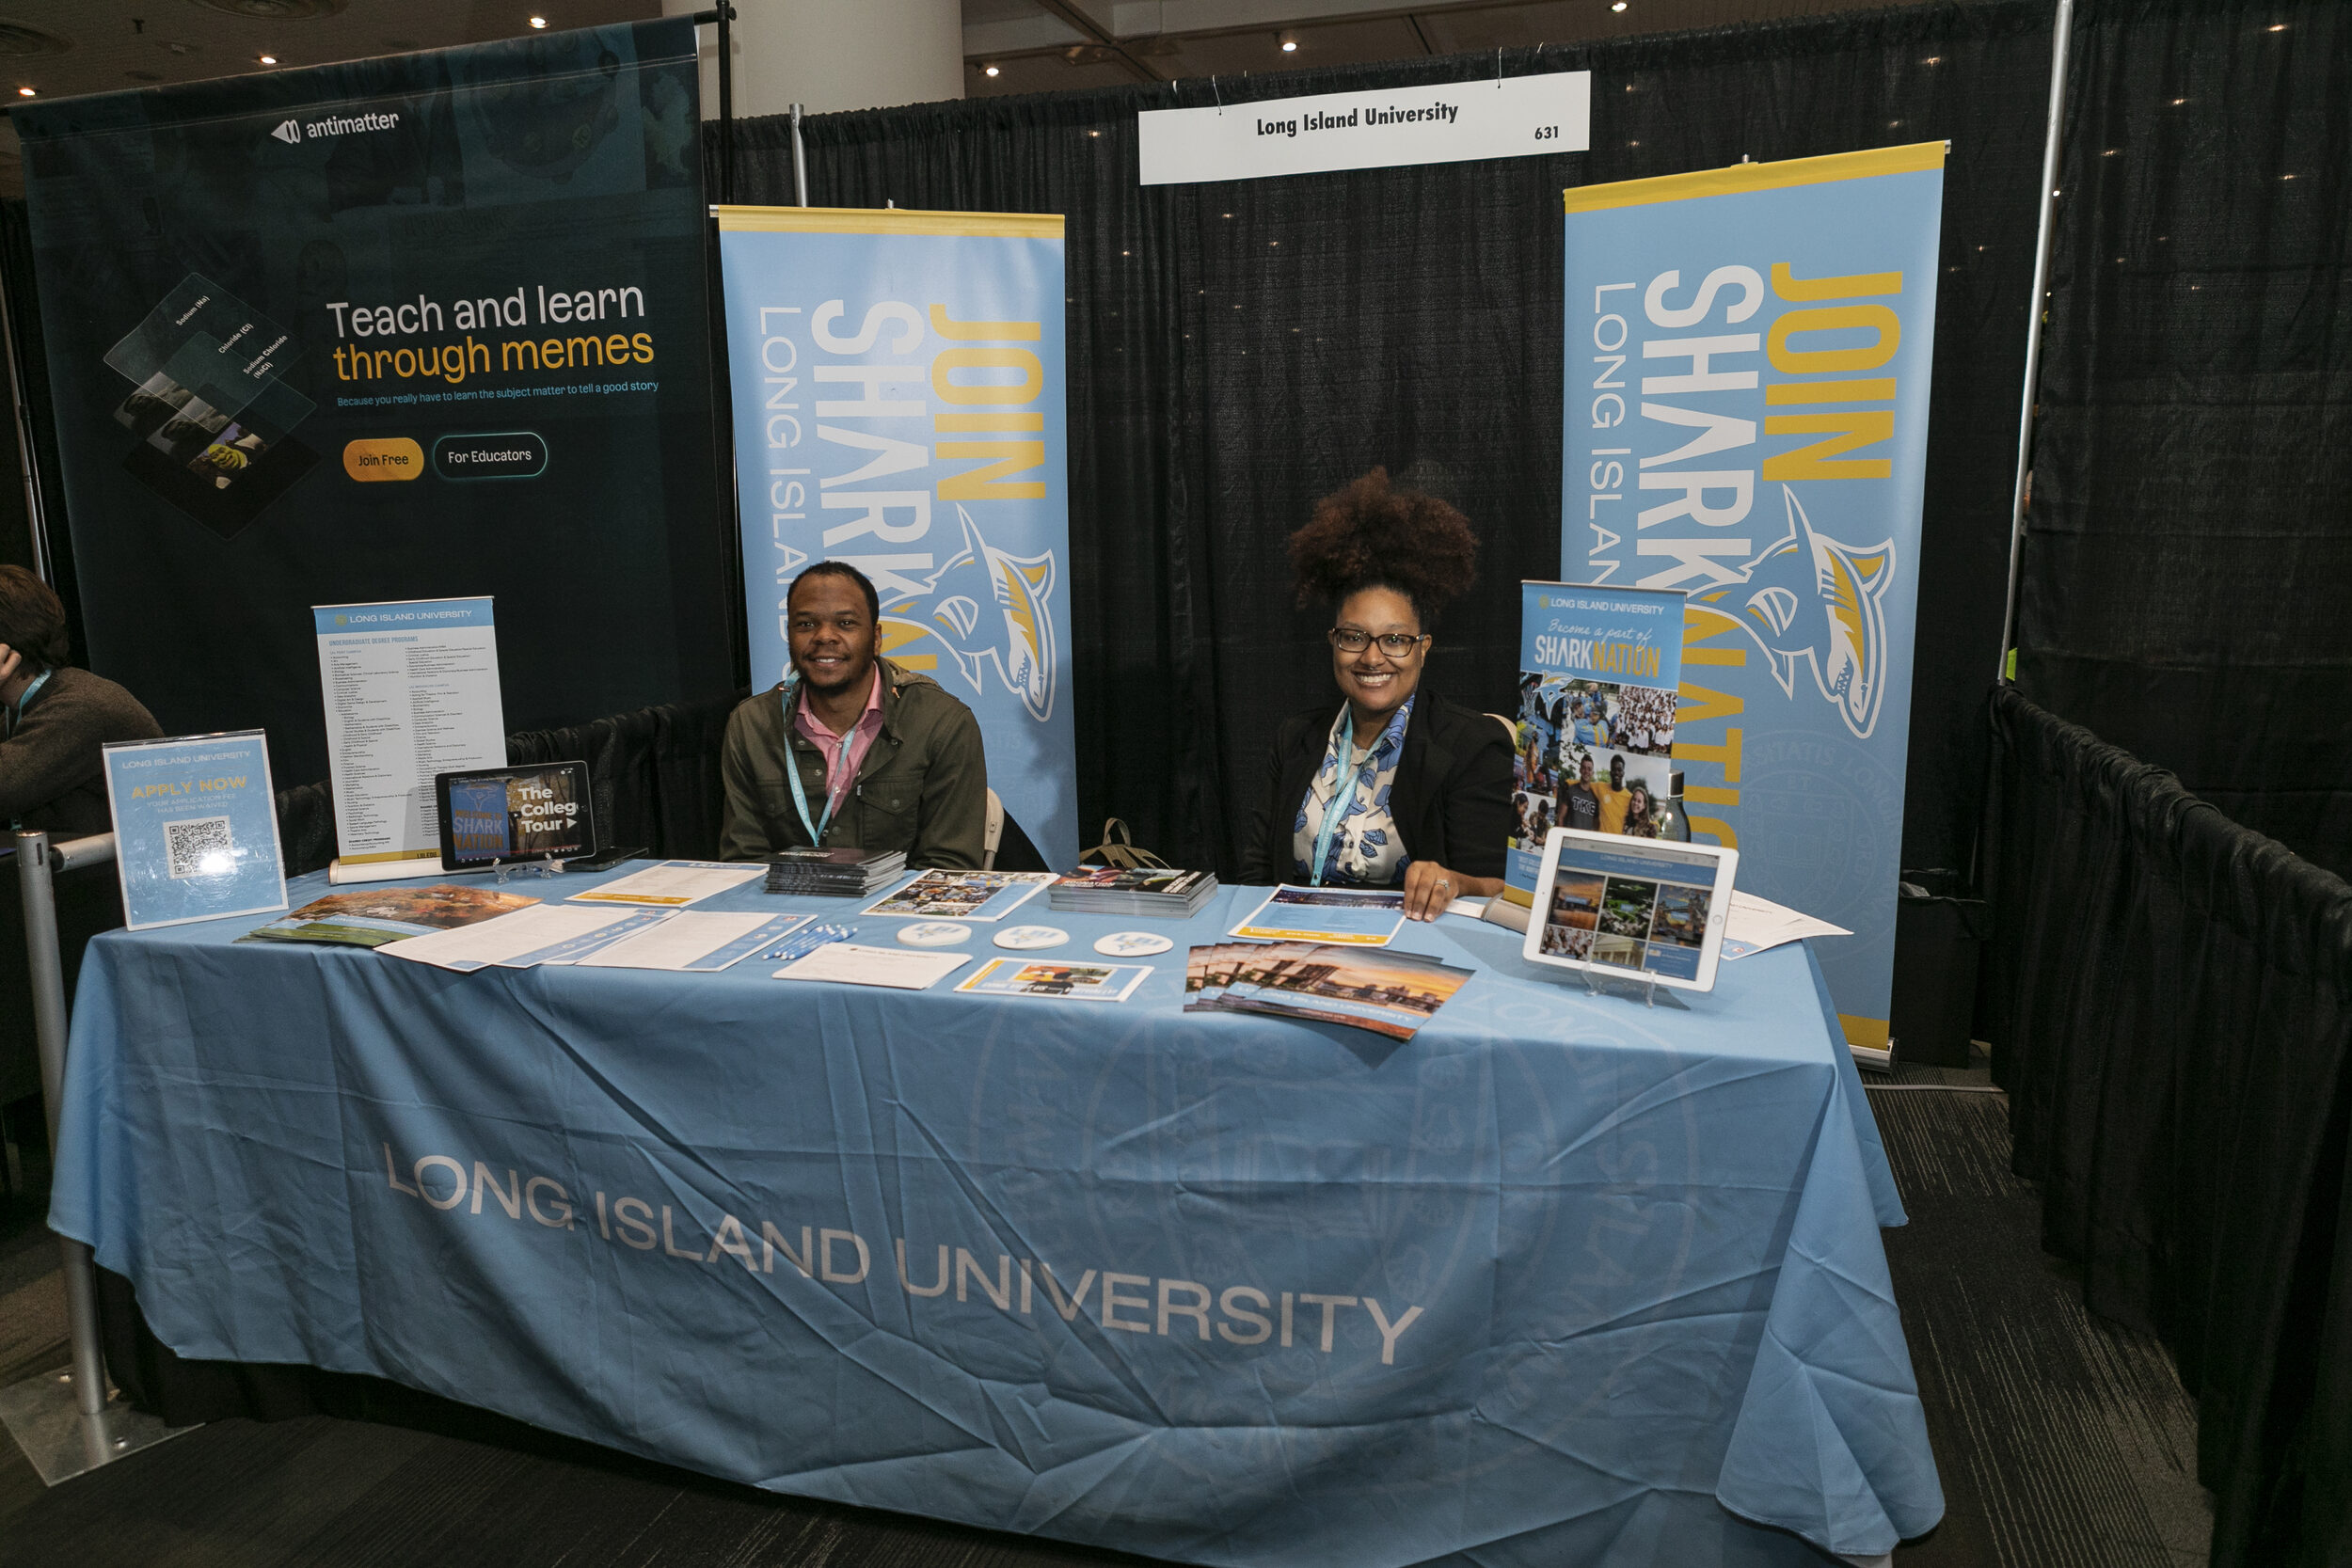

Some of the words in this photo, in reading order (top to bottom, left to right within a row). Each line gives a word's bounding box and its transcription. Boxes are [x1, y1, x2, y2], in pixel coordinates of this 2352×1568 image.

[306, 113, 400, 138] antimatter
[1257, 119, 1297, 138] Long
[1303, 107, 1358, 131] Island
[1365, 102, 1459, 126] University
[1534, 126, 1559, 140] 631
[176, 306, 198, 326] Sodium
[195, 294, 211, 309] (Na)
[326, 294, 444, 339] Teach
[453, 287, 527, 330] and
[537, 285, 645, 325] learn
[217, 332, 242, 354] Chloride
[243, 355, 264, 374] Sodium
[262, 335, 288, 357] Chloride
[1591, 281, 1637, 429] LONG
[332, 336, 490, 384] through
[501, 332, 655, 372] memes
[759, 307, 802, 449] LONG
[1762, 261, 1903, 481] JOIN
[337, 396, 373, 406] Because
[375, 396, 391, 406] you
[392, 393, 418, 404] really
[420, 392, 441, 403] have
[442, 391, 453, 402] to
[453, 389, 477, 401] learn
[479, 388, 495, 399] the
[496, 388, 532, 400] subject
[532, 386, 564, 397] matter
[566, 385, 578, 394] to
[579, 383, 594, 394] tell
[595, 385, 602, 393] a
[602, 381, 628, 395] good
[630, 380, 660, 393] story
[930, 303, 1046, 501] JOIN
[358, 454, 380, 467] Join
[382, 453, 409, 467] Free
[448, 451, 469, 464] For
[471, 449, 532, 463] Educators
[349, 614, 377, 624] LONG
[379, 612, 415, 622] ISLAND
[417, 610, 472, 620] UNIVERSITY
[1550, 598, 1574, 610] LONG
[1577, 600, 1608, 611] ISLAND
[1610, 603, 1665, 615] UNIVERSITY
[328, 638, 371, 647] UNDERGRADUATE
[372, 637, 391, 645] DEGREE
[391, 636, 419, 644] PROGRAMS
[1548, 618, 1591, 636] Become
[1594, 627, 1603, 637] a
[1601, 627, 1633, 645] part
[1635, 627, 1653, 652] of
[122, 759, 151, 769] LONG
[154, 756, 191, 767] ISLAND
[192, 751, 251, 763] UNIVERSITY
[131, 782, 193, 799] APPLY
[199, 775, 247, 792] NOW
[518, 786, 553, 800] The
[520, 801, 579, 816] Colleg
[453, 817, 503, 834] SHARK
[521, 819, 563, 833] Tour
[382, 1142, 575, 1231] LONG
[596, 1190, 871, 1285] ISLAND
[896, 1237, 1425, 1367] UNIVERSITY
